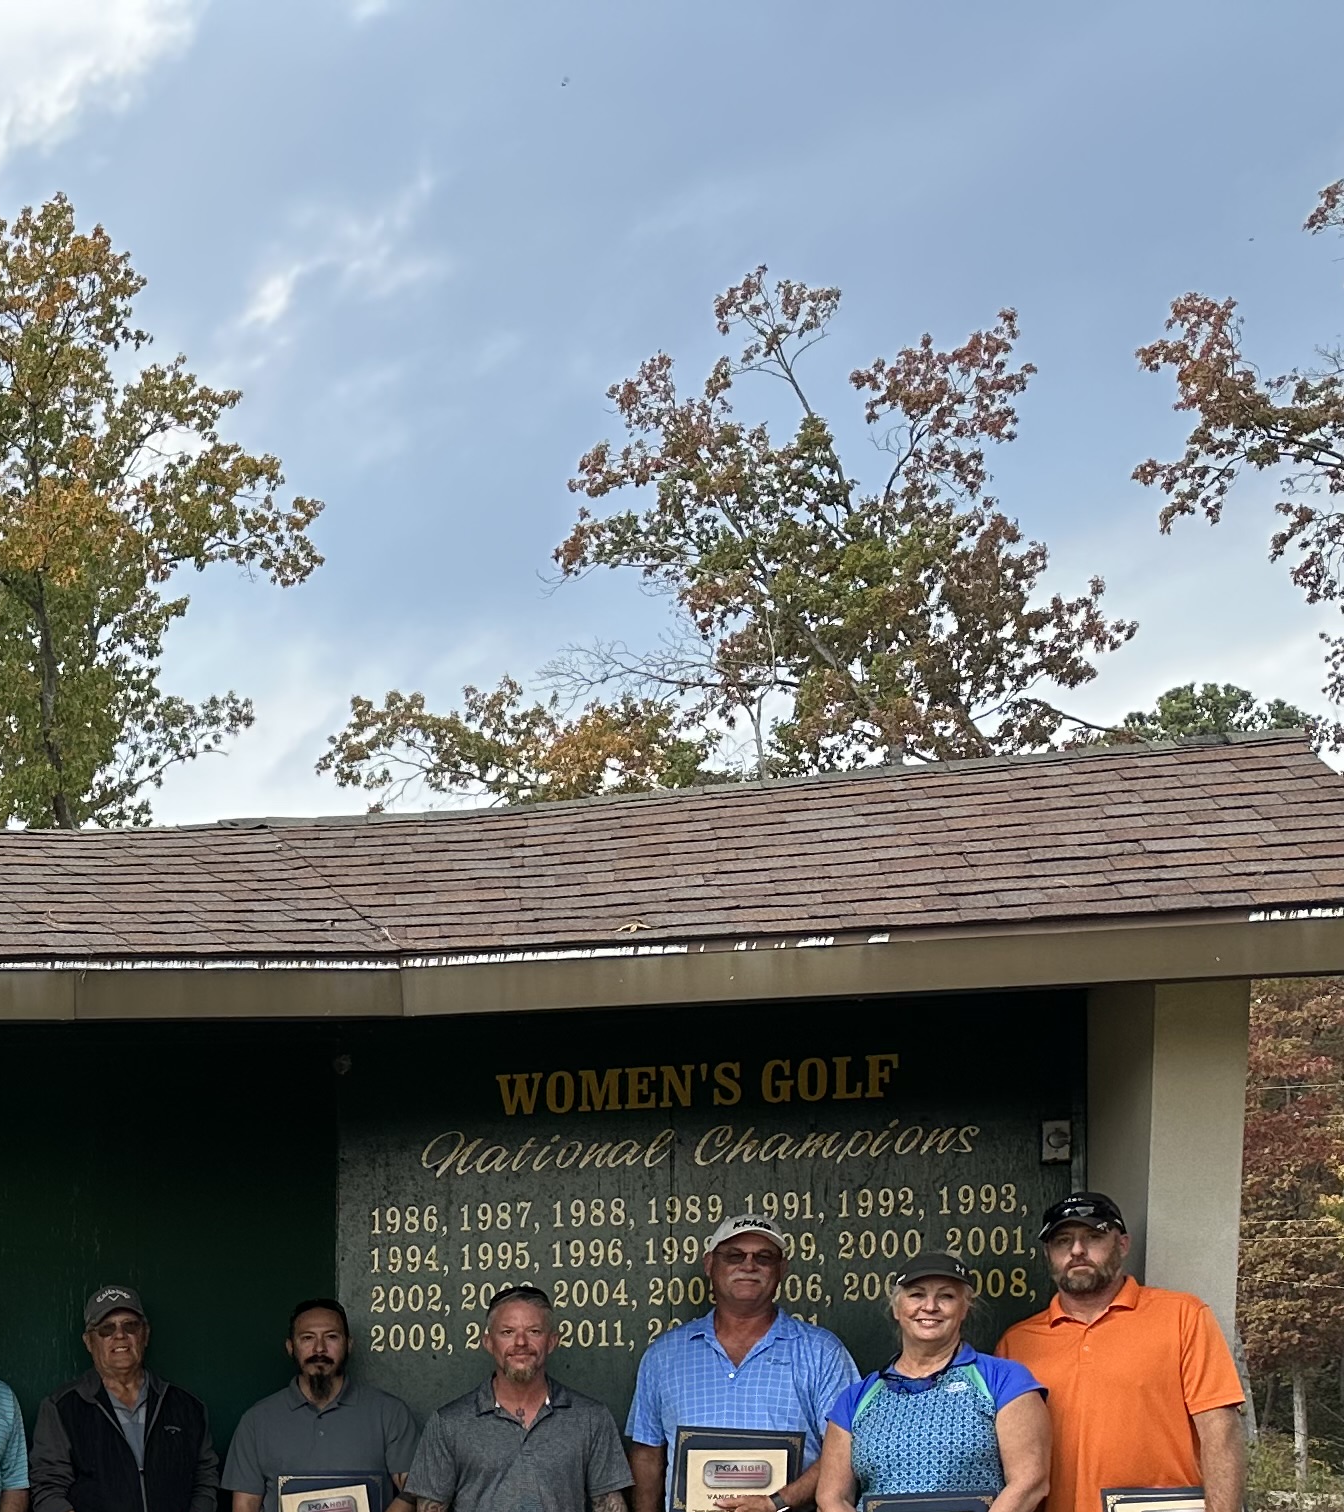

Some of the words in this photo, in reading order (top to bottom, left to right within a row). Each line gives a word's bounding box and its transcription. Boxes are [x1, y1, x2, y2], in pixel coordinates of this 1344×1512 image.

[496, 1059, 743, 1116] WOMEN'S
[761, 1052, 900, 1104] GOLF
[420, 1127, 675, 1180] National
[693, 1117, 982, 1167] Champions
[371, 1204, 448, 1237] 1986,
[459, 1200, 541, 1234] 1987,
[552, 1197, 636, 1230] 1988,
[744, 1190, 825, 1225] 1991,
[837, 1186, 925, 1222] 1992,
[938, 1183, 1028, 1218] 1993,
[370, 1243, 449, 1277] 1994,
[460, 1240, 541, 1273] 1995,
[551, 1236, 632, 1271] 1996,
[945, 1225, 1037, 1261] 2001,
[370, 1282, 451, 1317] 2002,
[553, 1277, 638, 1311] 2004,
[370, 1321, 454, 1356] 2009,
[557, 1318, 635, 1352] 2011,
[308, 1503, 329, 1511] PGA
